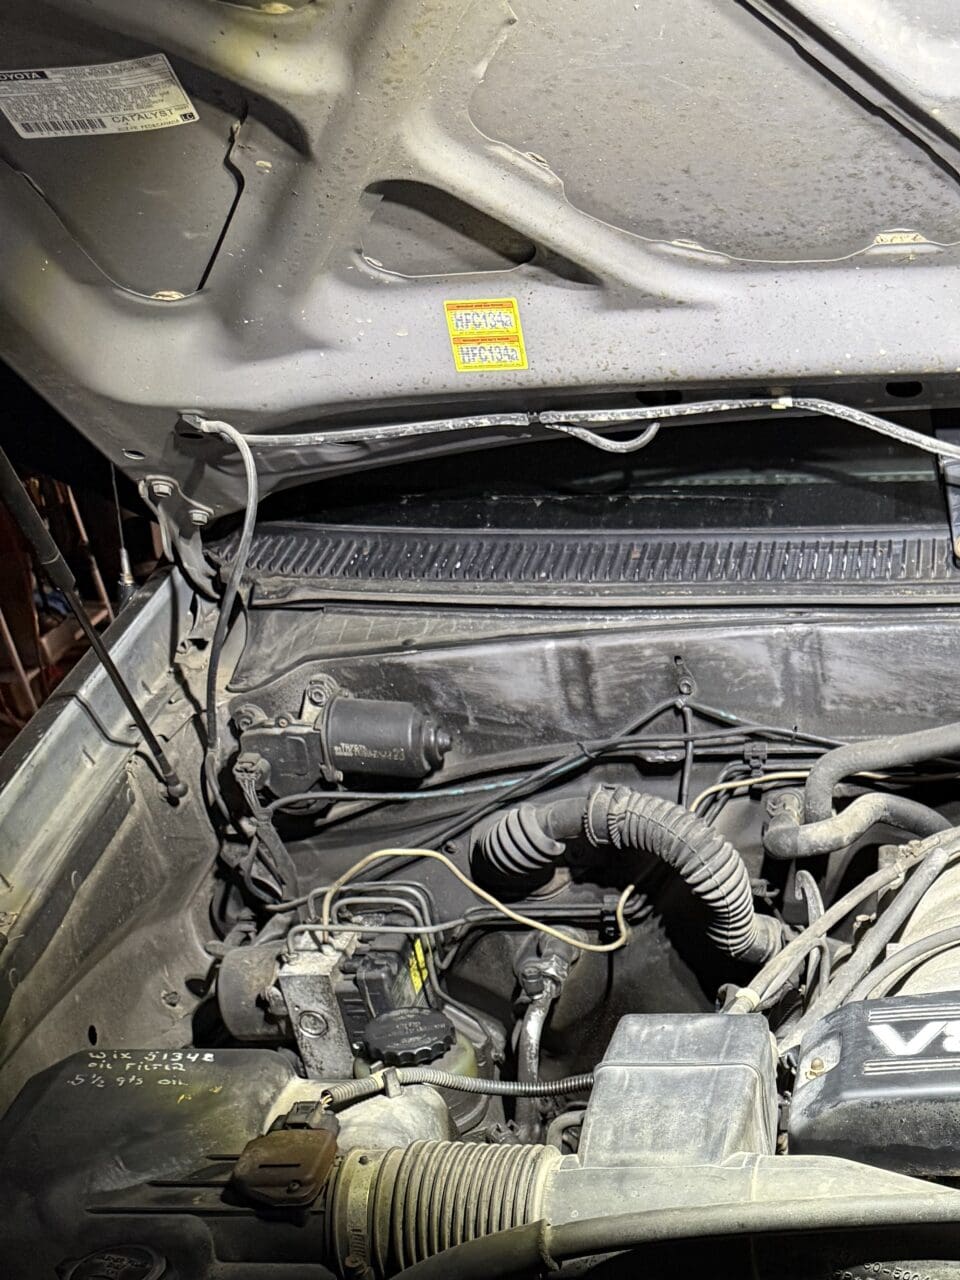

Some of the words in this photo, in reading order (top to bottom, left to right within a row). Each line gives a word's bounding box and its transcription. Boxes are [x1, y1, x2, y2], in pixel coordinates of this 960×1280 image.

[112, 109, 174, 123] CATALYST
[454, 311, 513, 329] HFC134a
[459, 345, 519, 363] HFC134a
